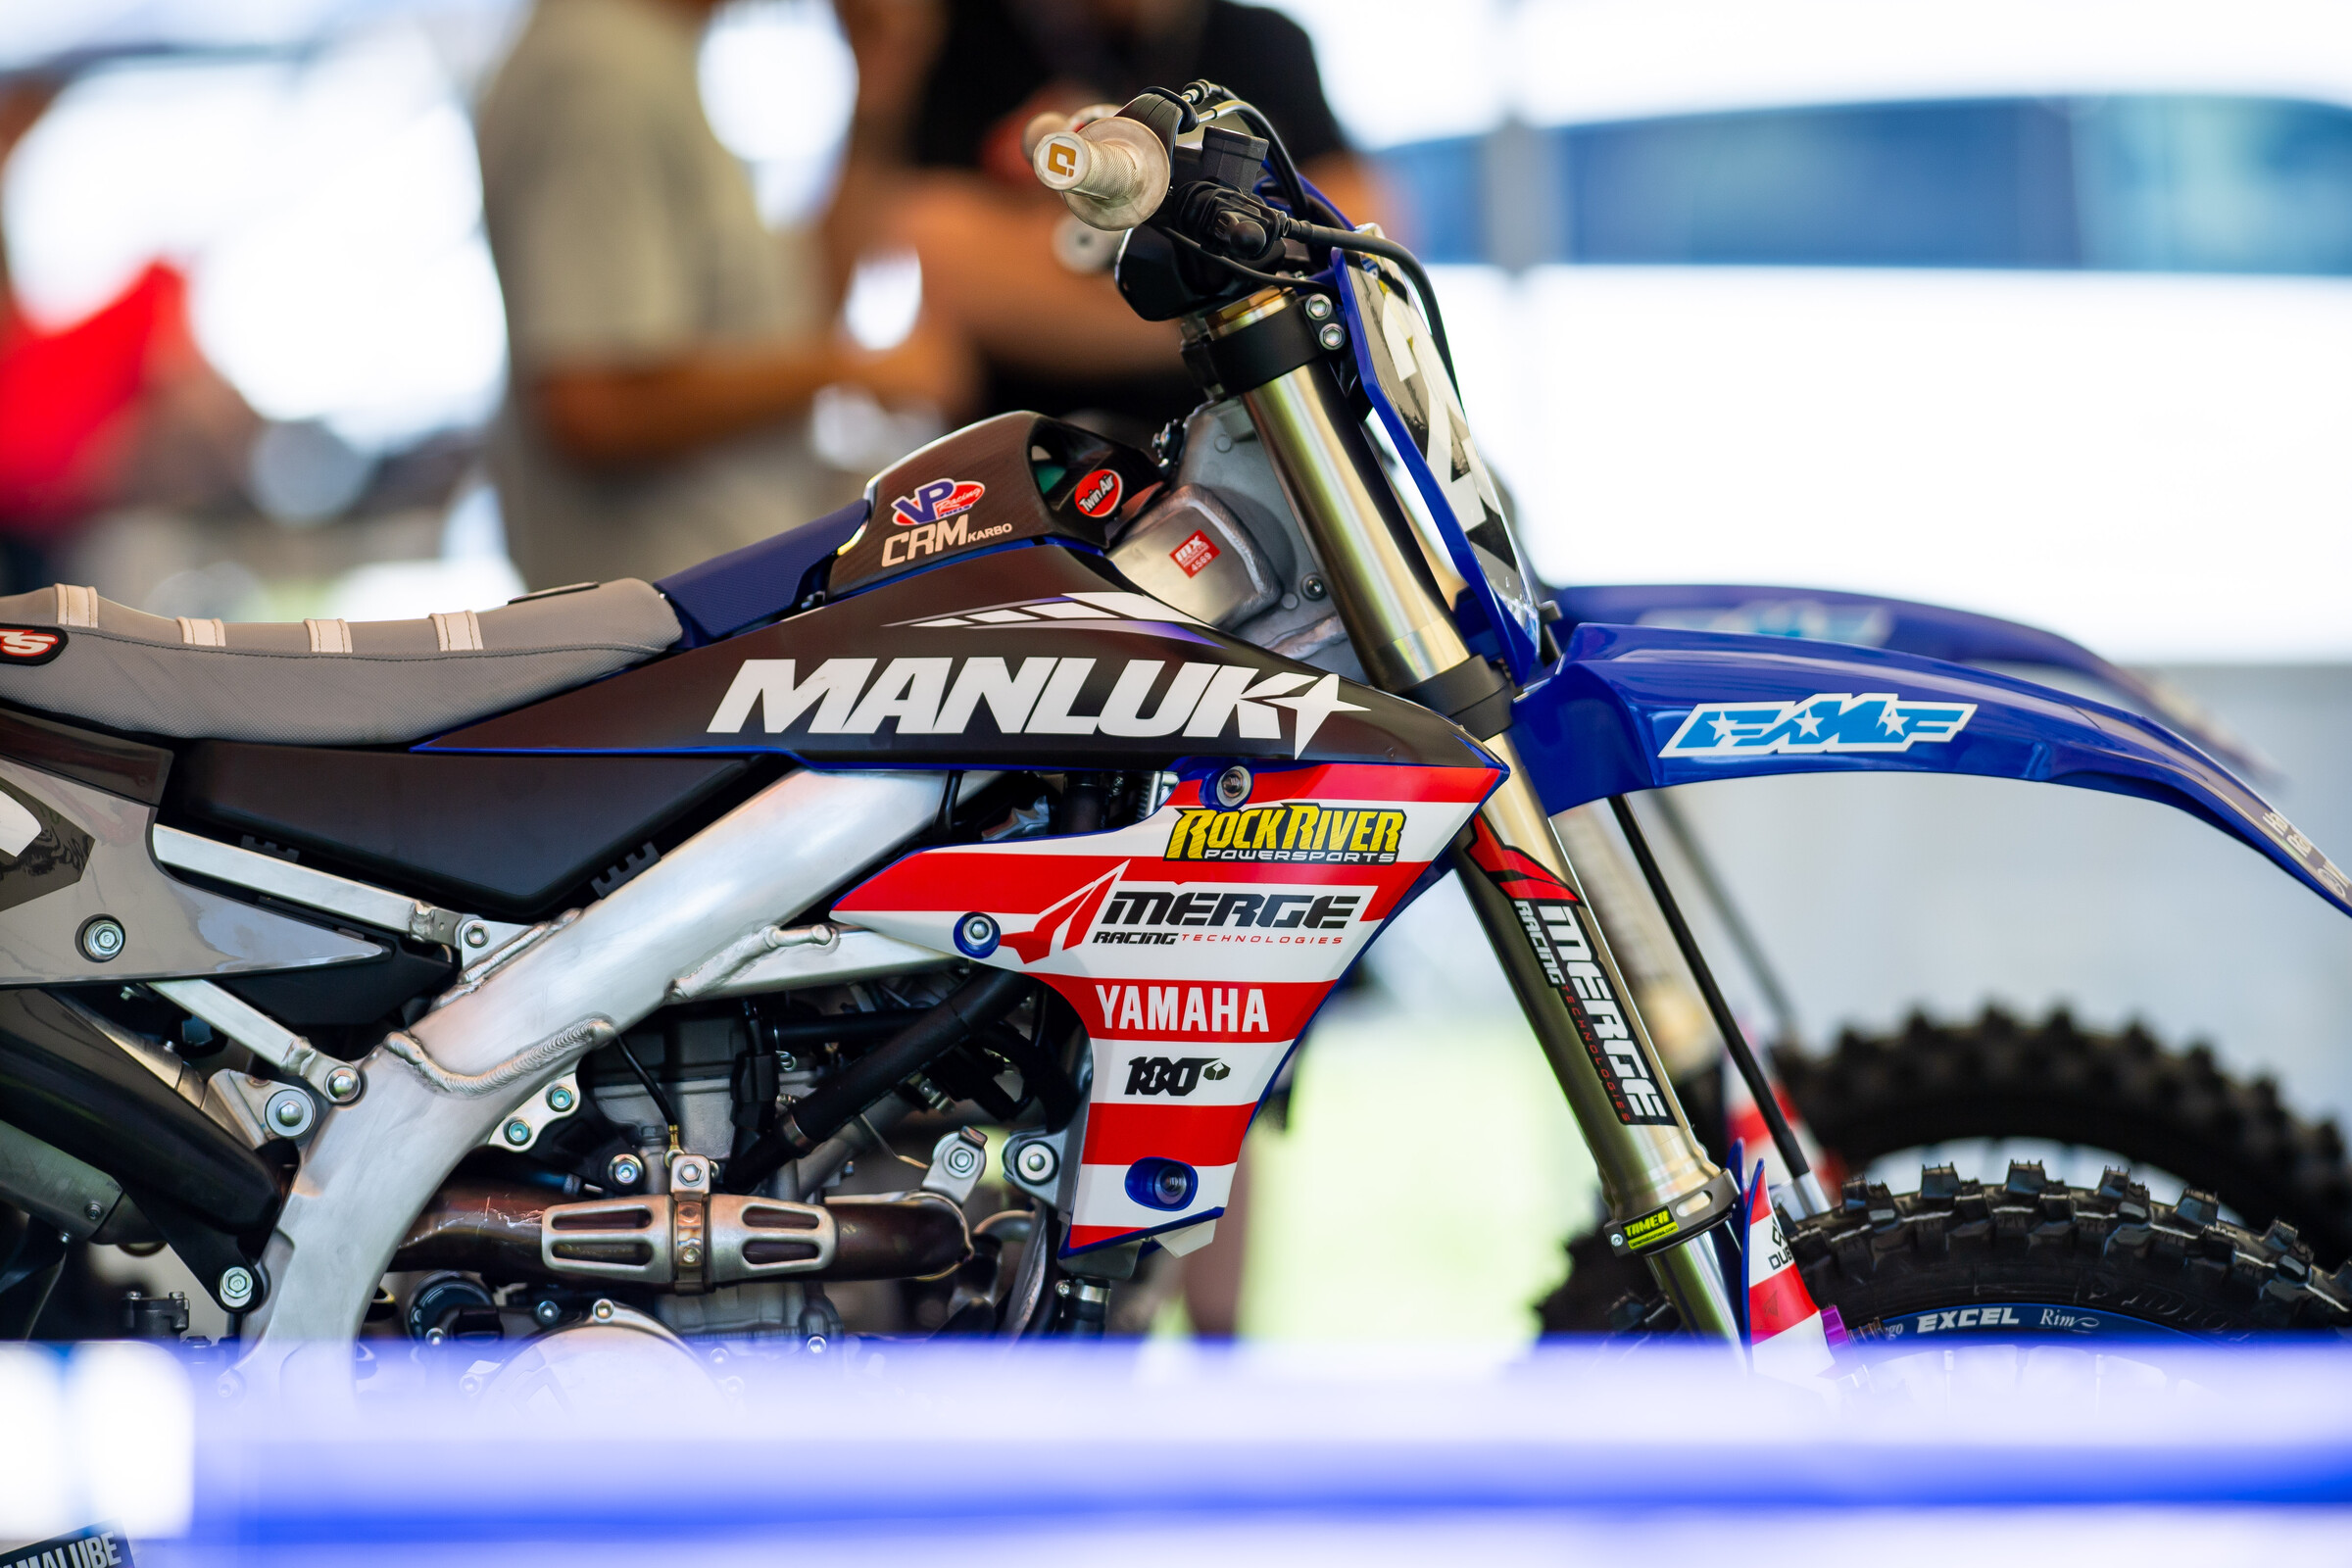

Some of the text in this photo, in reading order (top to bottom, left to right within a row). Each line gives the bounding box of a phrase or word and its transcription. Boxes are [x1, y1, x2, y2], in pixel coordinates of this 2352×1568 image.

[894, 479, 956, 524] VP
[934, 487, 982, 511] Racing
[1078, 474, 1115, 513] Twin Air
[881, 514, 1013, 567] CRM KARBO
[707, 657, 1319, 739] MANLUK
[1670, 698, 1968, 752] FMF
[1204, 849, 1396, 862] POWERSPORTS
[1101, 891, 1361, 929] MERGE
[1092, 932, 1344, 945] RACING TECHNOLOGIES
[1095, 985, 1270, 1033] YAMAHA
[1513, 901, 1632, 1123] RACING TECHNOLOGIES
[1538, 905, 1668, 1117] MERGE
[1623, 1209, 1670, 1238] TAMER
[1916, 1307, 2020, 1334] EXCEL
[2039, 1308, 2099, 1328] Rim
